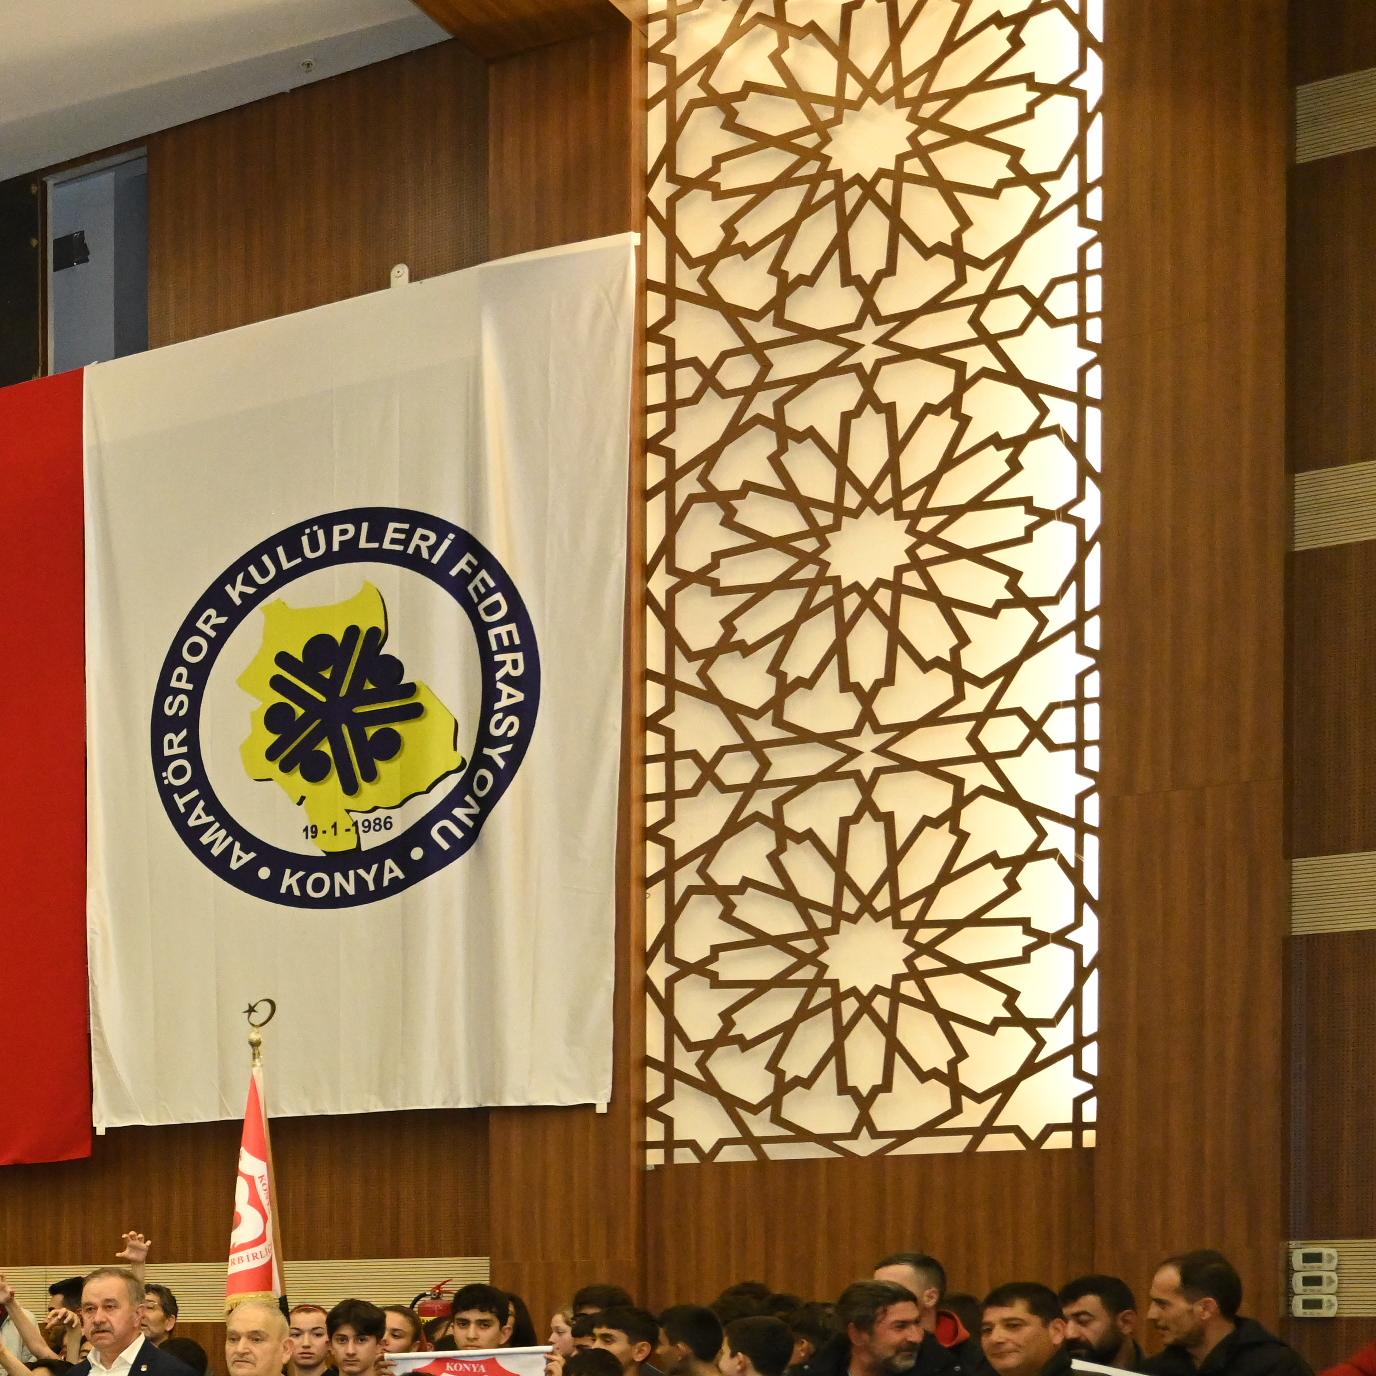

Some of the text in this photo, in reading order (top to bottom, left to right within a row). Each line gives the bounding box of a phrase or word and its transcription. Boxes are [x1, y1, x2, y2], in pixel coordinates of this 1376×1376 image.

[162, 521, 526, 871] AMATÖR SPOR KULÜPLERİ FEDERASYONU
[280, 861, 406, 898] KONYA
[446, 1361, 486, 1373] KONYA
